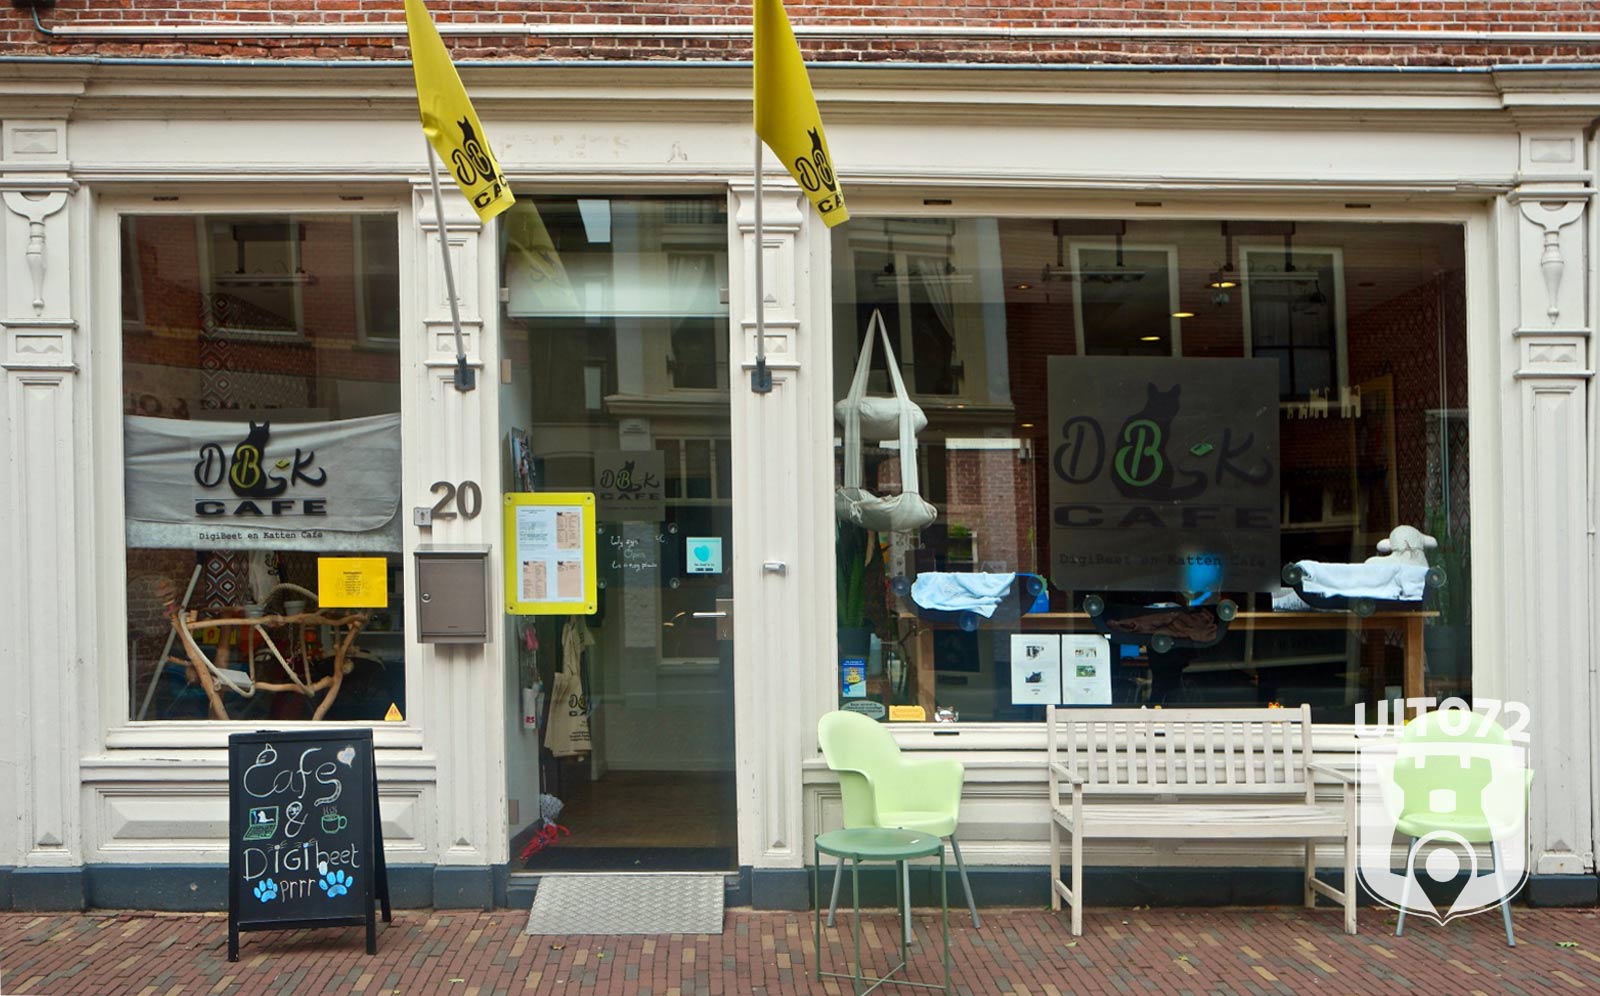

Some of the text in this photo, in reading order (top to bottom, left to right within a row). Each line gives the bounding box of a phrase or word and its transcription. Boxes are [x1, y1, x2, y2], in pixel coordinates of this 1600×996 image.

[195, 500, 327, 515] CAFE
[430, 480, 482, 520] 20
[1053, 504, 1274, 529] CAFE
[199, 532, 242, 541] DigiBeet
[285, 801, 309, 838] &
[279, 878, 316, 903] prrr
